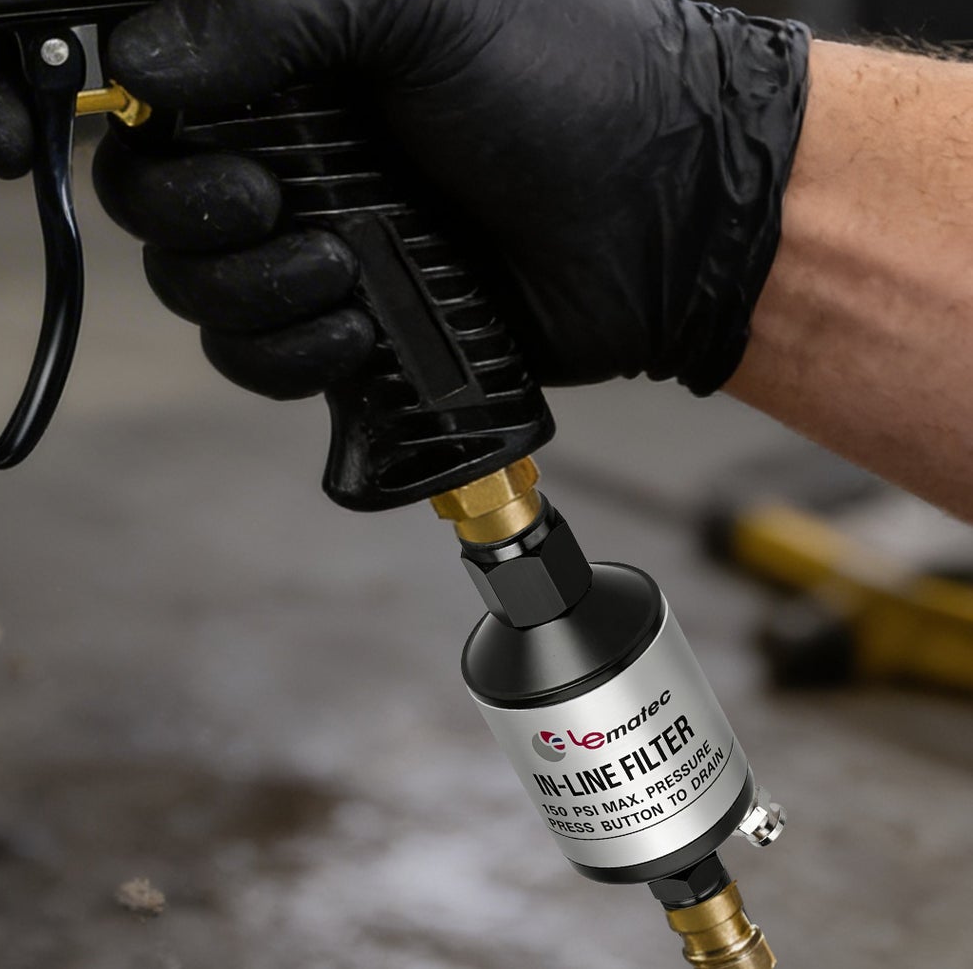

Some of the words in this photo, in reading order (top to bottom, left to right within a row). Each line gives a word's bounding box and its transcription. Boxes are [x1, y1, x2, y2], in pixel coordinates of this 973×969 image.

[533, 763, 622, 797] IN-LINE
[618, 714, 695, 781] FILTER
[566, 689, 671, 750] Lematec
[542, 803, 567, 817] 150
[573, 803, 599, 818] PSI
[602, 793, 644, 814] MAX.
[647, 740, 712, 799] PRESSURE
[548, 817, 595, 833] PRESS
[603, 803, 664, 831] BUTTON
[667, 788, 688, 807] TO
[691, 747, 725, 791] DRAIN
